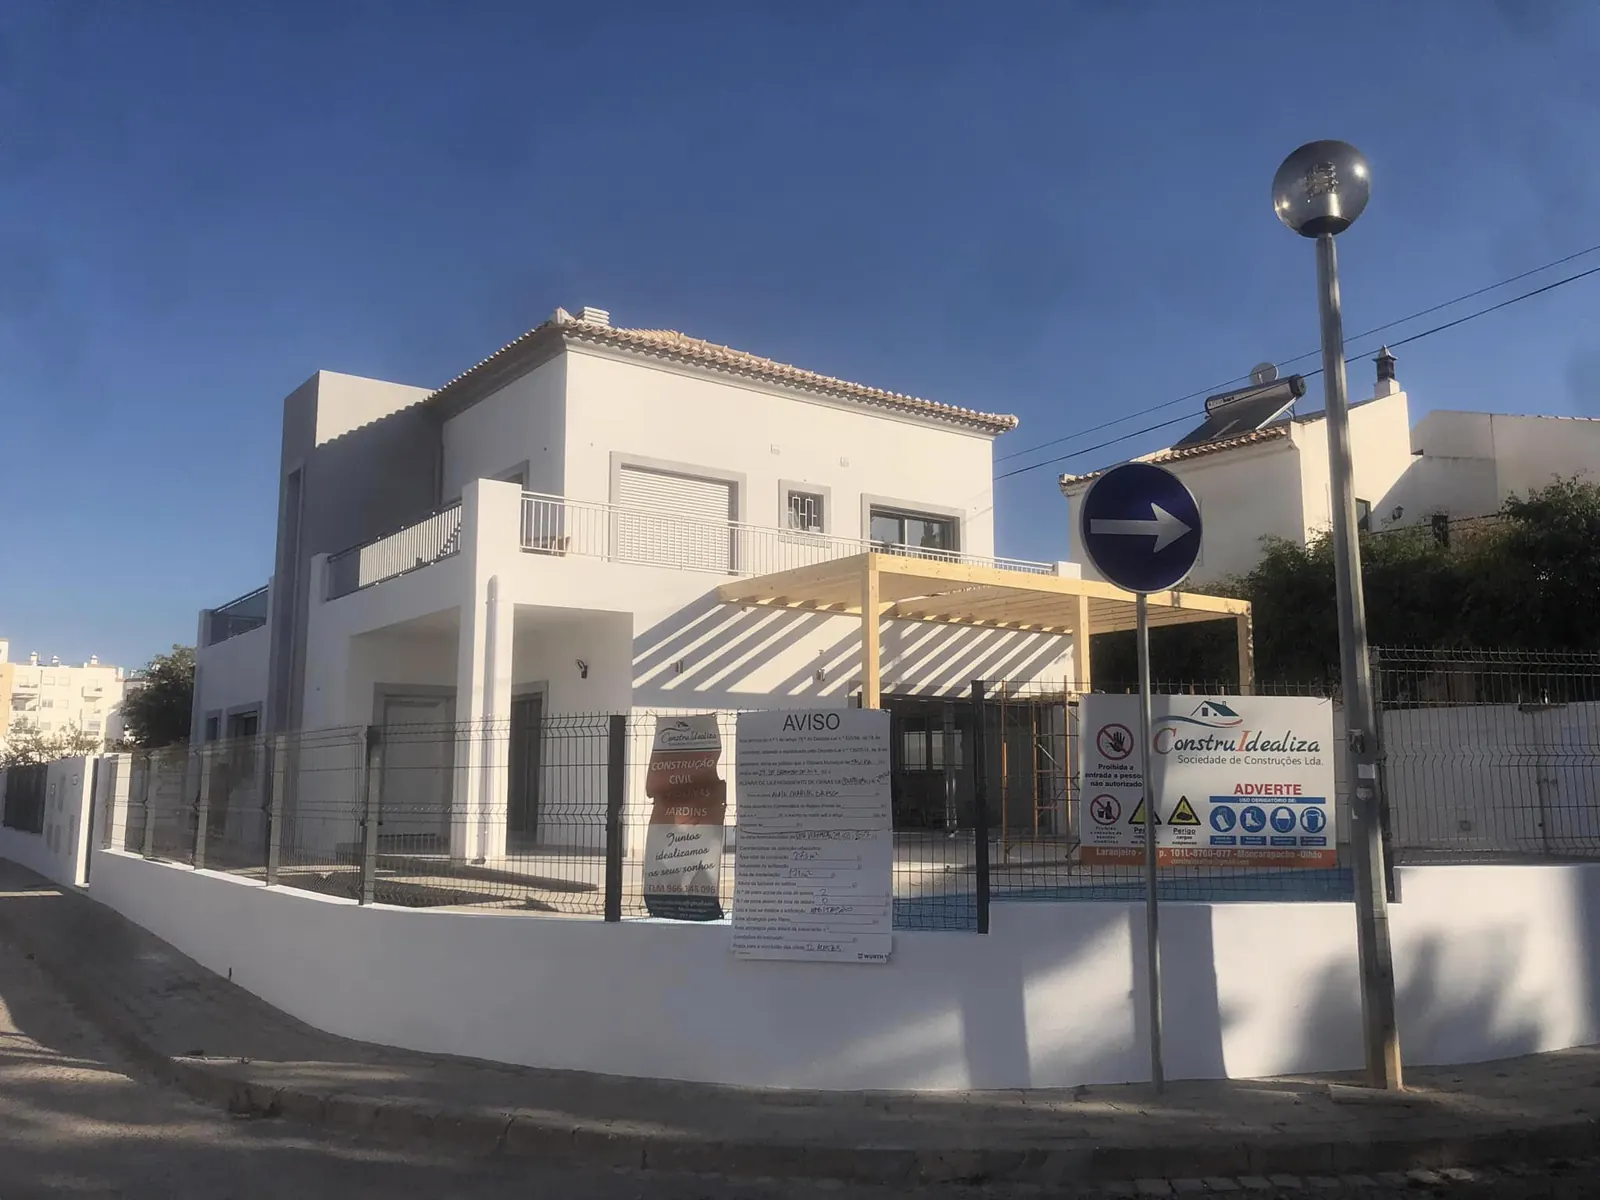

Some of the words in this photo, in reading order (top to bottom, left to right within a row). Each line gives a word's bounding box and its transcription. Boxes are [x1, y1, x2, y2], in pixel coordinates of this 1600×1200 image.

[783, 713, 841, 731] AVISO
[1153, 727, 1321, 755] ConstruIdealiza
[652, 758, 714, 771] CONSTRUÇÃO
[1177, 755, 1227, 765] Sociedade
[1229, 755, 1242, 765] de
[1244, 756, 1302, 767] Construções
[1304, 757, 1324, 767] Lda.
[669, 774, 693, 785] CIVIL
[1234, 783, 1302, 796] ADVERTE
[665, 806, 708, 817] JARDINS
[1173, 827, 1196, 836] Perigo
[666, 832, 702, 847] Juntos
[655, 848, 711, 861] idealizamos
[1096, 848, 1137, 857] Laranjeiro
[660, 868, 681, 876] seus
[682, 860, 716, 874] sonhos
